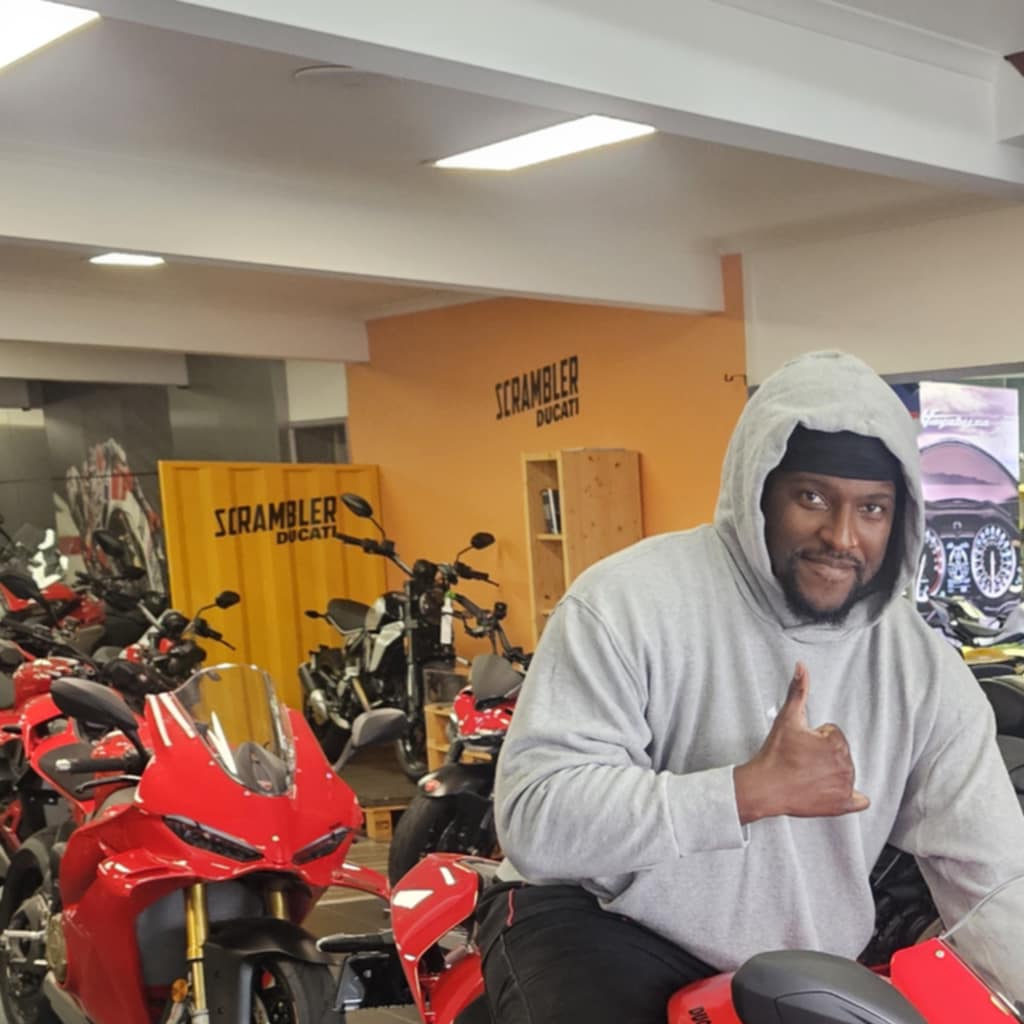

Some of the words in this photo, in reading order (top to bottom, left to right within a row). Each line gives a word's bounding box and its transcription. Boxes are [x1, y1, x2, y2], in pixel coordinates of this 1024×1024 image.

[495, 355, 579, 420] SCRAMBLER
[536, 397, 579, 428] DUCATI
[214, 496, 337, 537] SCRAMBLER
[276, 526, 337, 545] DUCATI
